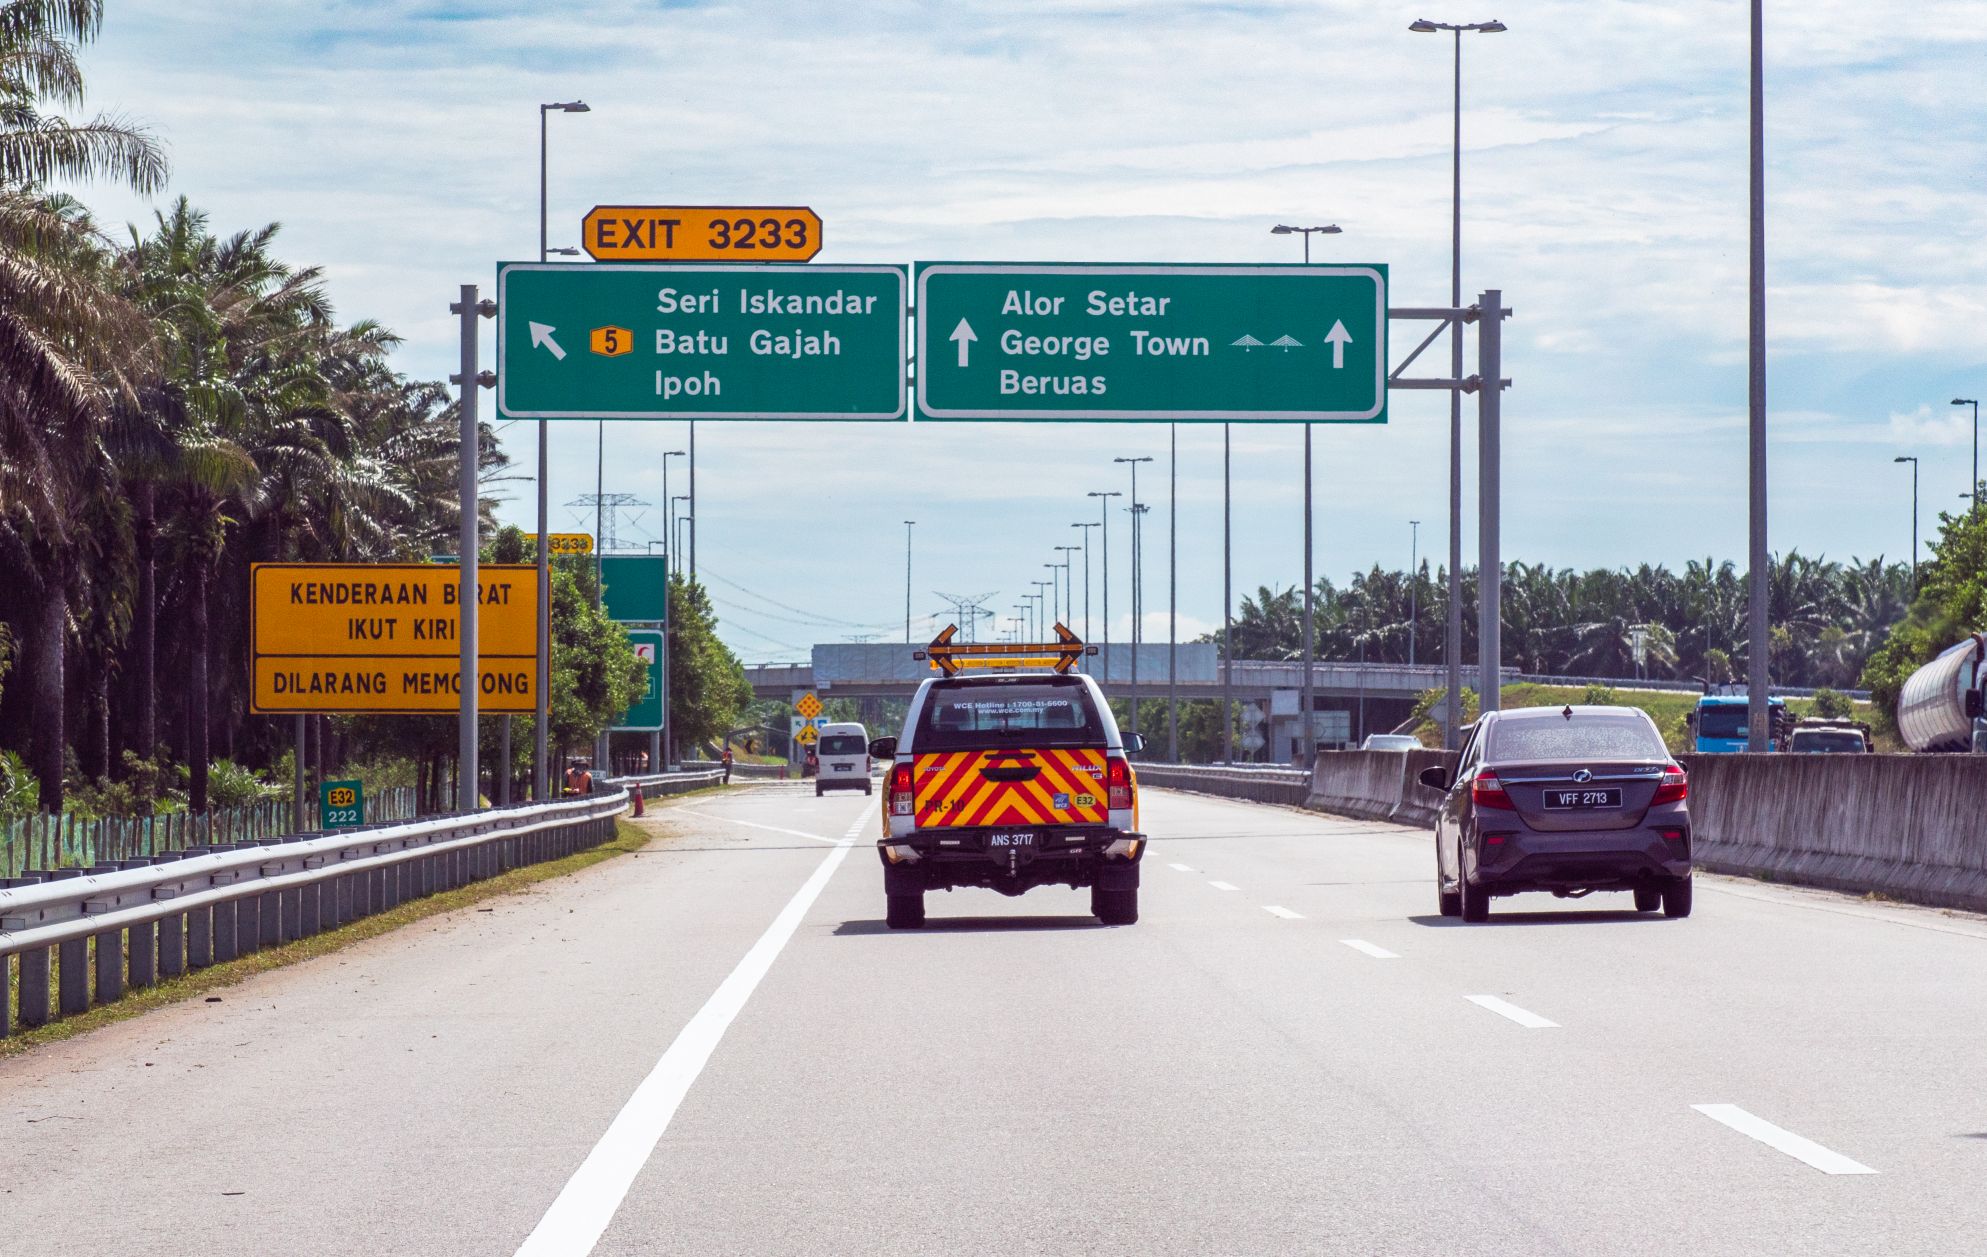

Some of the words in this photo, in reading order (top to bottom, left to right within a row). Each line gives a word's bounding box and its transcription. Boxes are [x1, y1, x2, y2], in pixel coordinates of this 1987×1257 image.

[598, 219, 681, 248] EXIT
[708, 218, 807, 249] 3233
[657, 288, 719, 314] Seri
[740, 289, 877, 315] Iskandar
[1001, 290, 1065, 316] Alor
[1086, 290, 1171, 316] Setar
[605, 329, 618, 353] 5
[656, 330, 728, 355] Batu
[749, 329, 841, 359] Gajah
[1000, 329, 1110, 361] George
[1130, 330, 1210, 356] Town
[655, 371, 721, 400] Ipoh
[1000, 369, 1107, 395] Beruas
[291, 583, 427, 604] KENDERAAN
[443, 583, 512, 605] BAT
[348, 618, 398, 640] IKUT
[413, 618, 455, 640] KIRI
[273, 672, 387, 694] DILARANG
[403, 672, 529, 695] MEMOONG
[330, 790, 353, 804] E32
[925, 799, 965, 812] PR-10
[1076, 796, 1094, 805] E32
[1559, 792, 1579, 805] VFF
[1583, 792, 1607, 804] 2713
[328, 810, 357, 823] 222
[991, 834, 1010, 846] ANS
[1012, 834, 1034, 846] 3717
